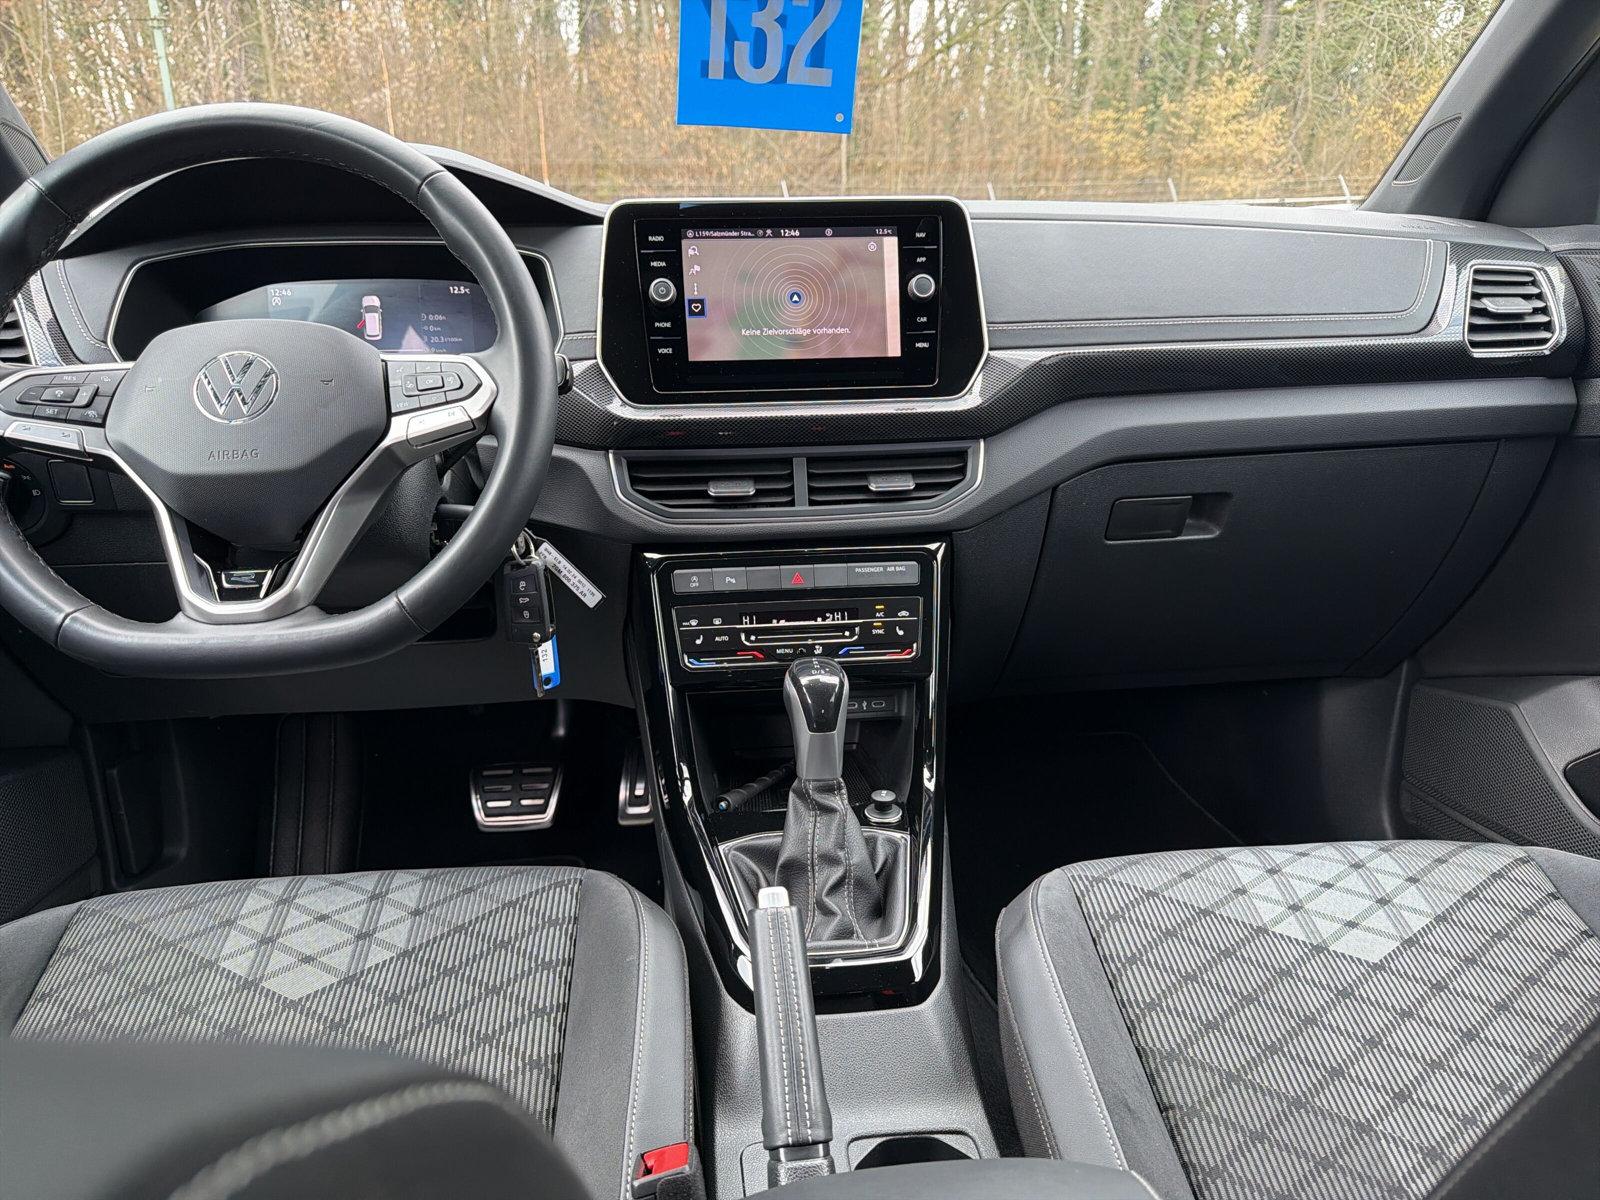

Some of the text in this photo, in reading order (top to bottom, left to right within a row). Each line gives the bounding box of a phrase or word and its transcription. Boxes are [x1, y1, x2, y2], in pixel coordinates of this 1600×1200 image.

[708, 0, 842, 87] 132
[780, 229, 800, 237] 12:46
[270, 288, 292, 296] 12:46
[741, 326, 851, 336] Keine Zielvorschläge vorhanden.
[207, 448, 260, 461] AIRBAG
